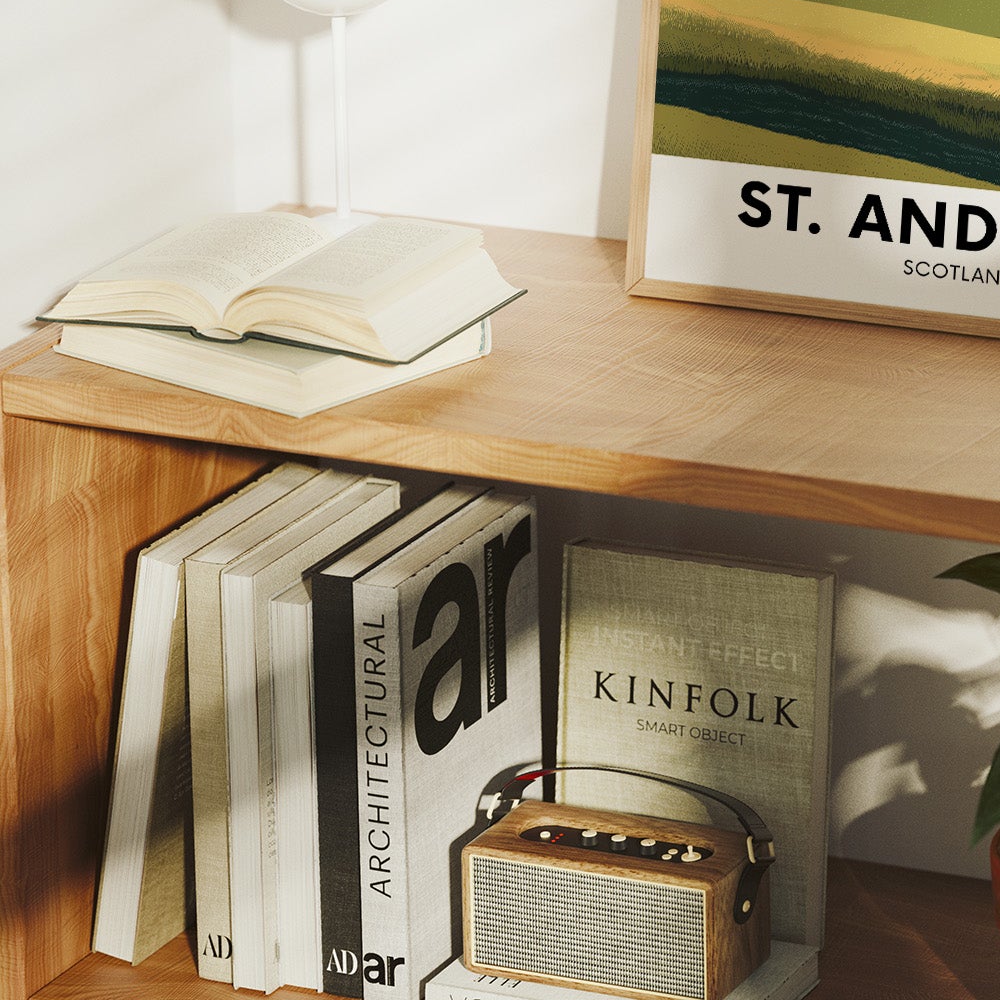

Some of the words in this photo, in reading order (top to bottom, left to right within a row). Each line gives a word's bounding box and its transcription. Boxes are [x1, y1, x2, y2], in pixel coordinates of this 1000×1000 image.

[737, 180, 821, 235] ST.
[486, 548, 495, 596] REVIEW
[487, 598, 497, 704] ARCHITECTURAL
[593, 670, 800, 729] KINFOLK
[362, 613, 392, 899] ARCHITECTURAL
[636, 718, 687, 738] SMART
[689, 726, 747, 746] OBJECT
[202, 933, 233, 960] AD
[326, 948, 358, 976] AD
[363, 952, 405, 987] ar
